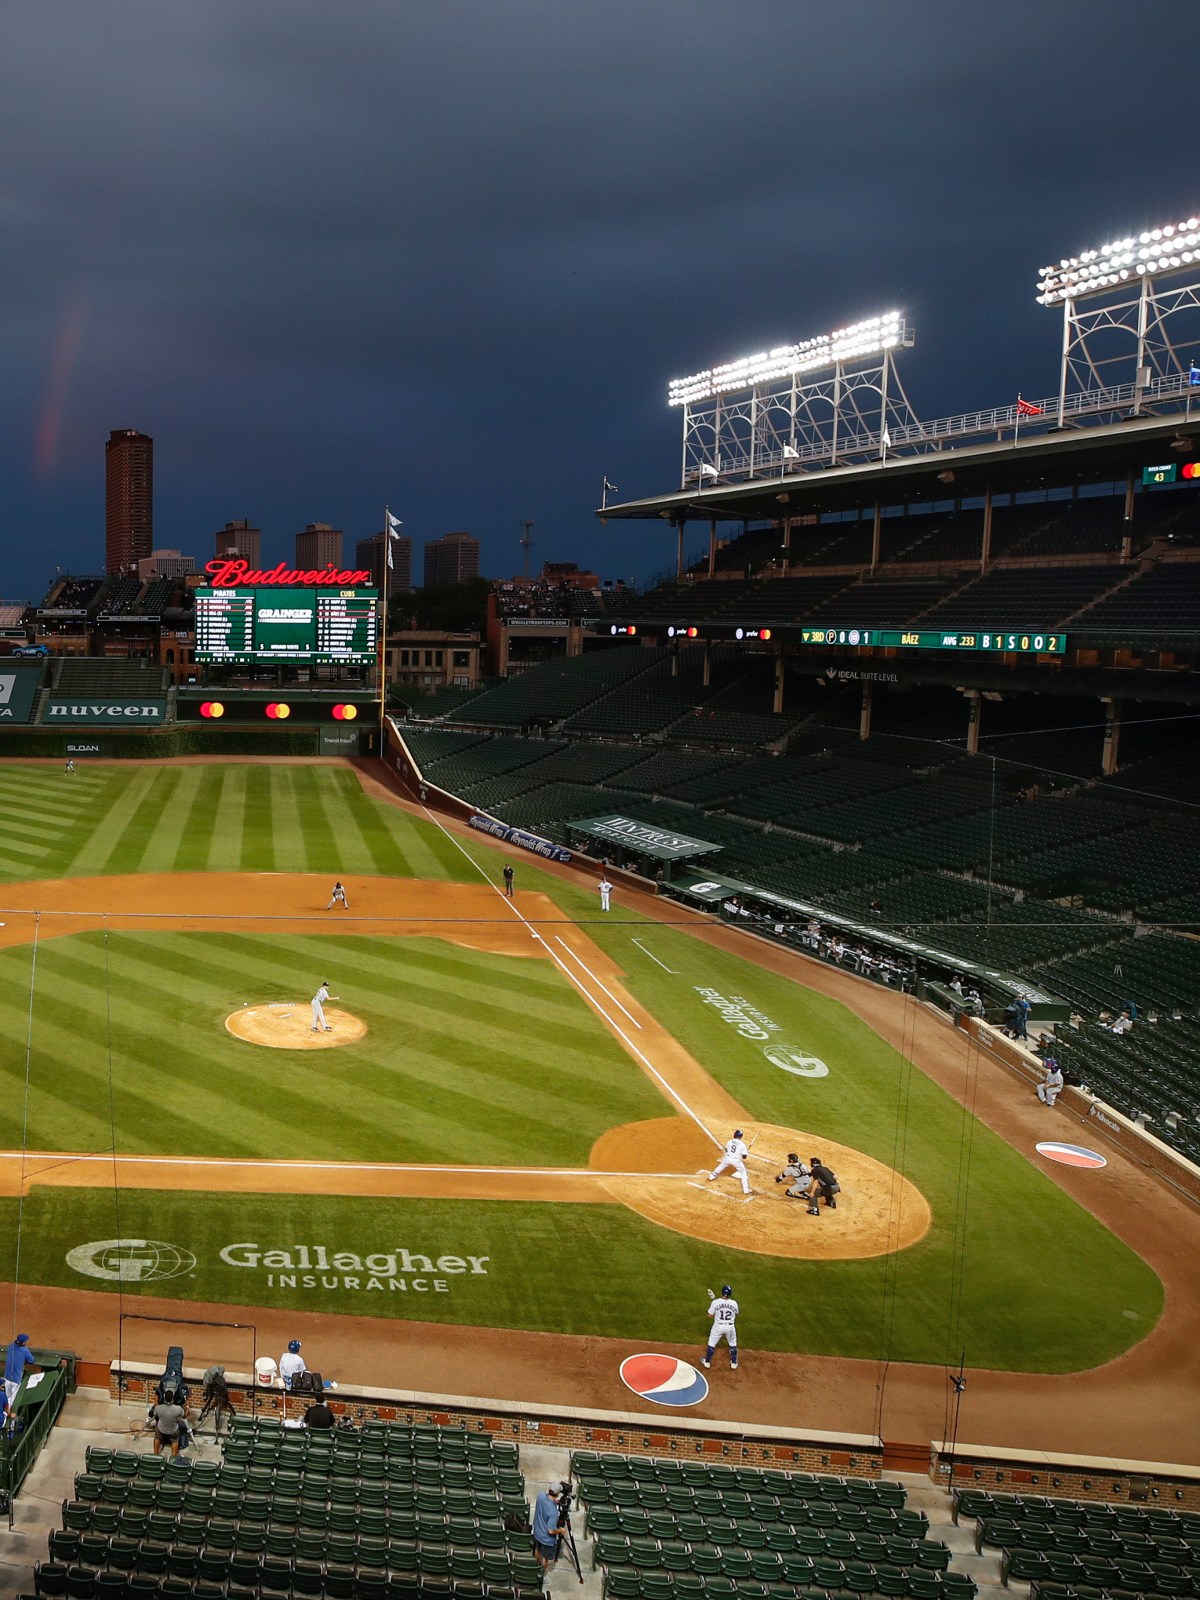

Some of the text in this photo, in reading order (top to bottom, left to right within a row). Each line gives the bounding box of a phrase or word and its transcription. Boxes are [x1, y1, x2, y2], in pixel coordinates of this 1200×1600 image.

[1154, 473, 1165, 482] 43
[205, 559, 371, 587] Budweiser
[340, 590, 356, 598] CUBS
[258, 608, 313, 618] GRAINGER
[811, 631, 869, 643] 3RD 0 1
[901, 633, 975, 647] BÁEZ AVG .233
[983, 636, 990, 647] B
[995, 636, 1002, 649] 1
[1008, 636, 1015, 649] S
[1021, 636, 1029, 649] 0
[1048, 637, 1056, 651] 2
[838, 671, 899, 682] IDEAL SUITE LEVEL
[50, 704, 160, 717] nuveen
[489, 824, 504, 838] Wrap
[591, 826, 658, 849] MORTGAGE
[602, 817, 700, 849] WINTRUST
[511, 832, 536, 850] Reynolds
[535, 841, 552, 858] Wrap
[692, 986, 769, 1040] Gallagher
[729, 995, 783, 1031] INSURANCE
[730, 1144, 737, 1154] 9
[219, 1242, 490, 1278] Gallagher
[267, 1273, 449, 1293] INSURANCE
[719, 1310, 732, 1321] 12
